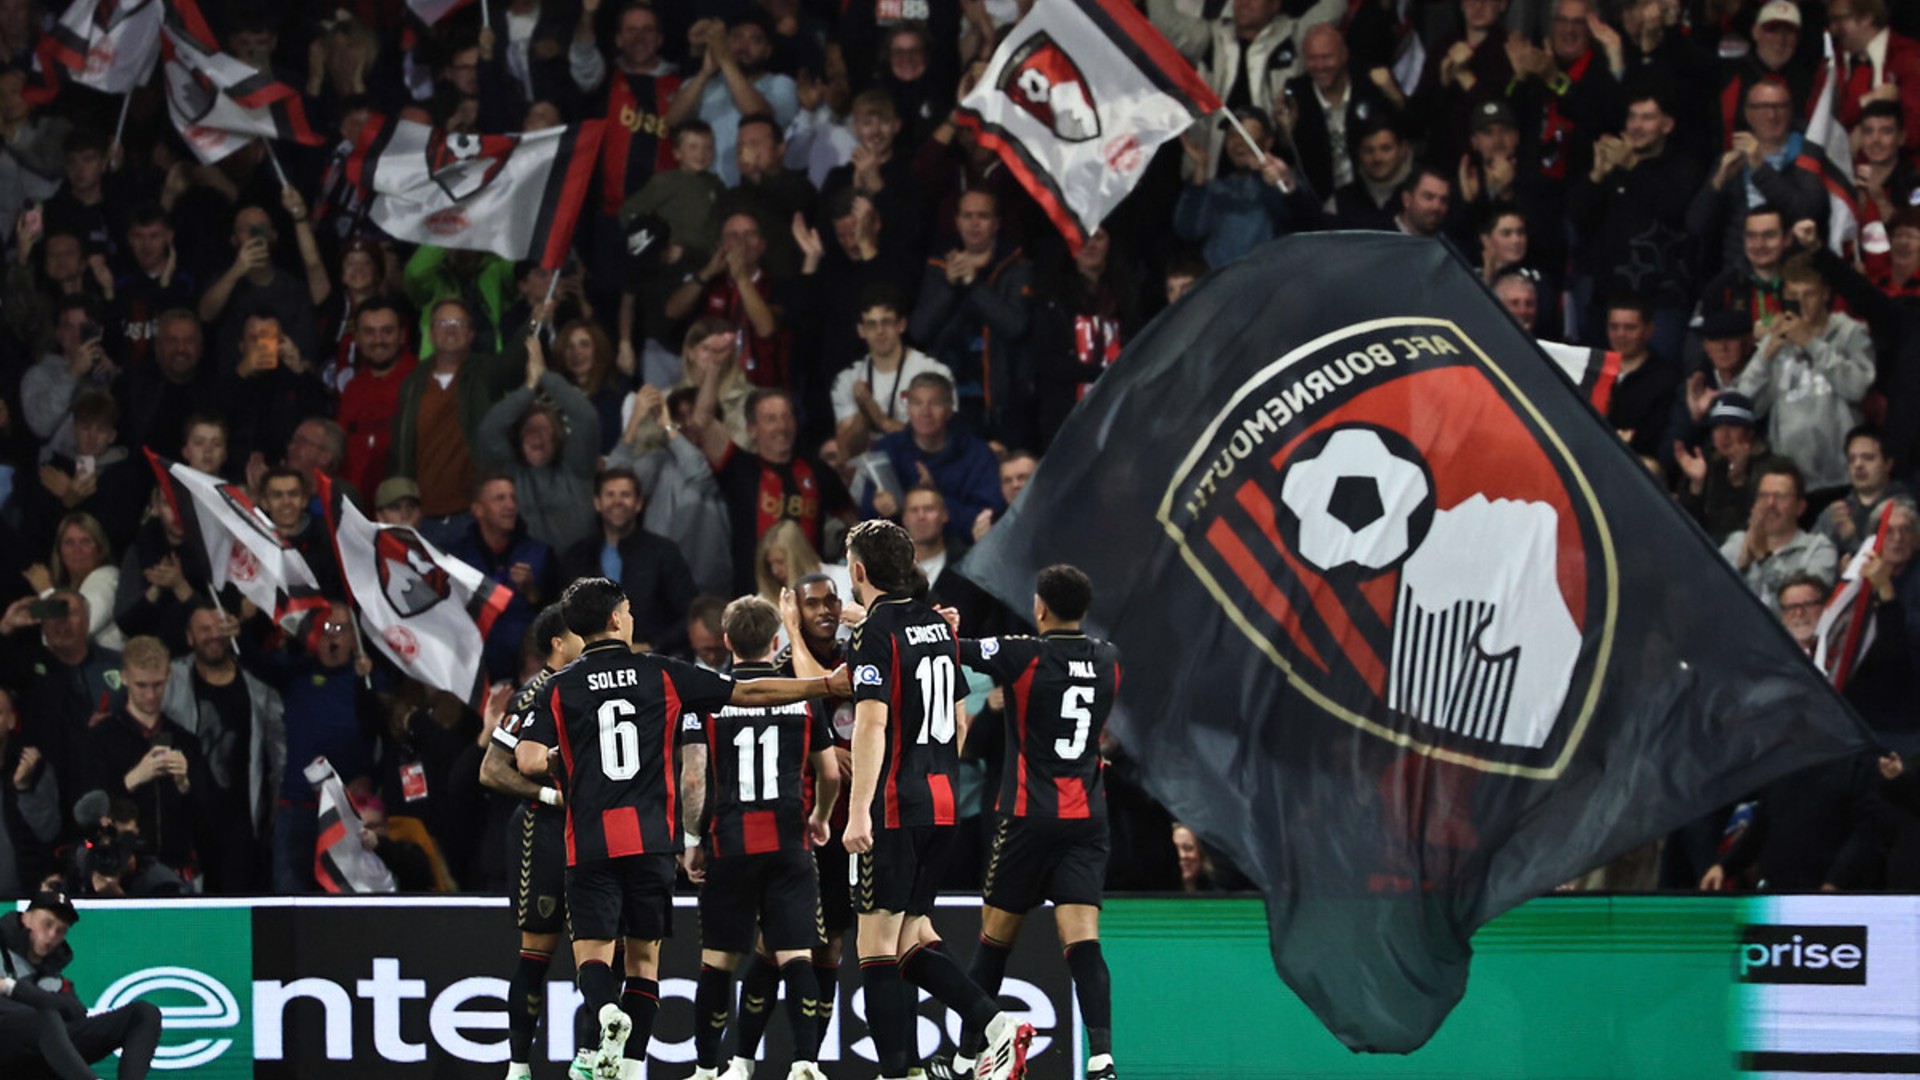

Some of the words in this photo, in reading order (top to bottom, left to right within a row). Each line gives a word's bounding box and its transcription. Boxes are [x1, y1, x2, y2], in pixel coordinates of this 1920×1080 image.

[587, 668, 639, 691] SOLER
[915, 655, 955, 744] 10
[597, 699, 641, 781] 6
[1053, 685, 1095, 760] 5
[733, 725, 779, 801] 11
[1740, 934, 1862, 975] prise
[86, 957, 1057, 1080] enterise
